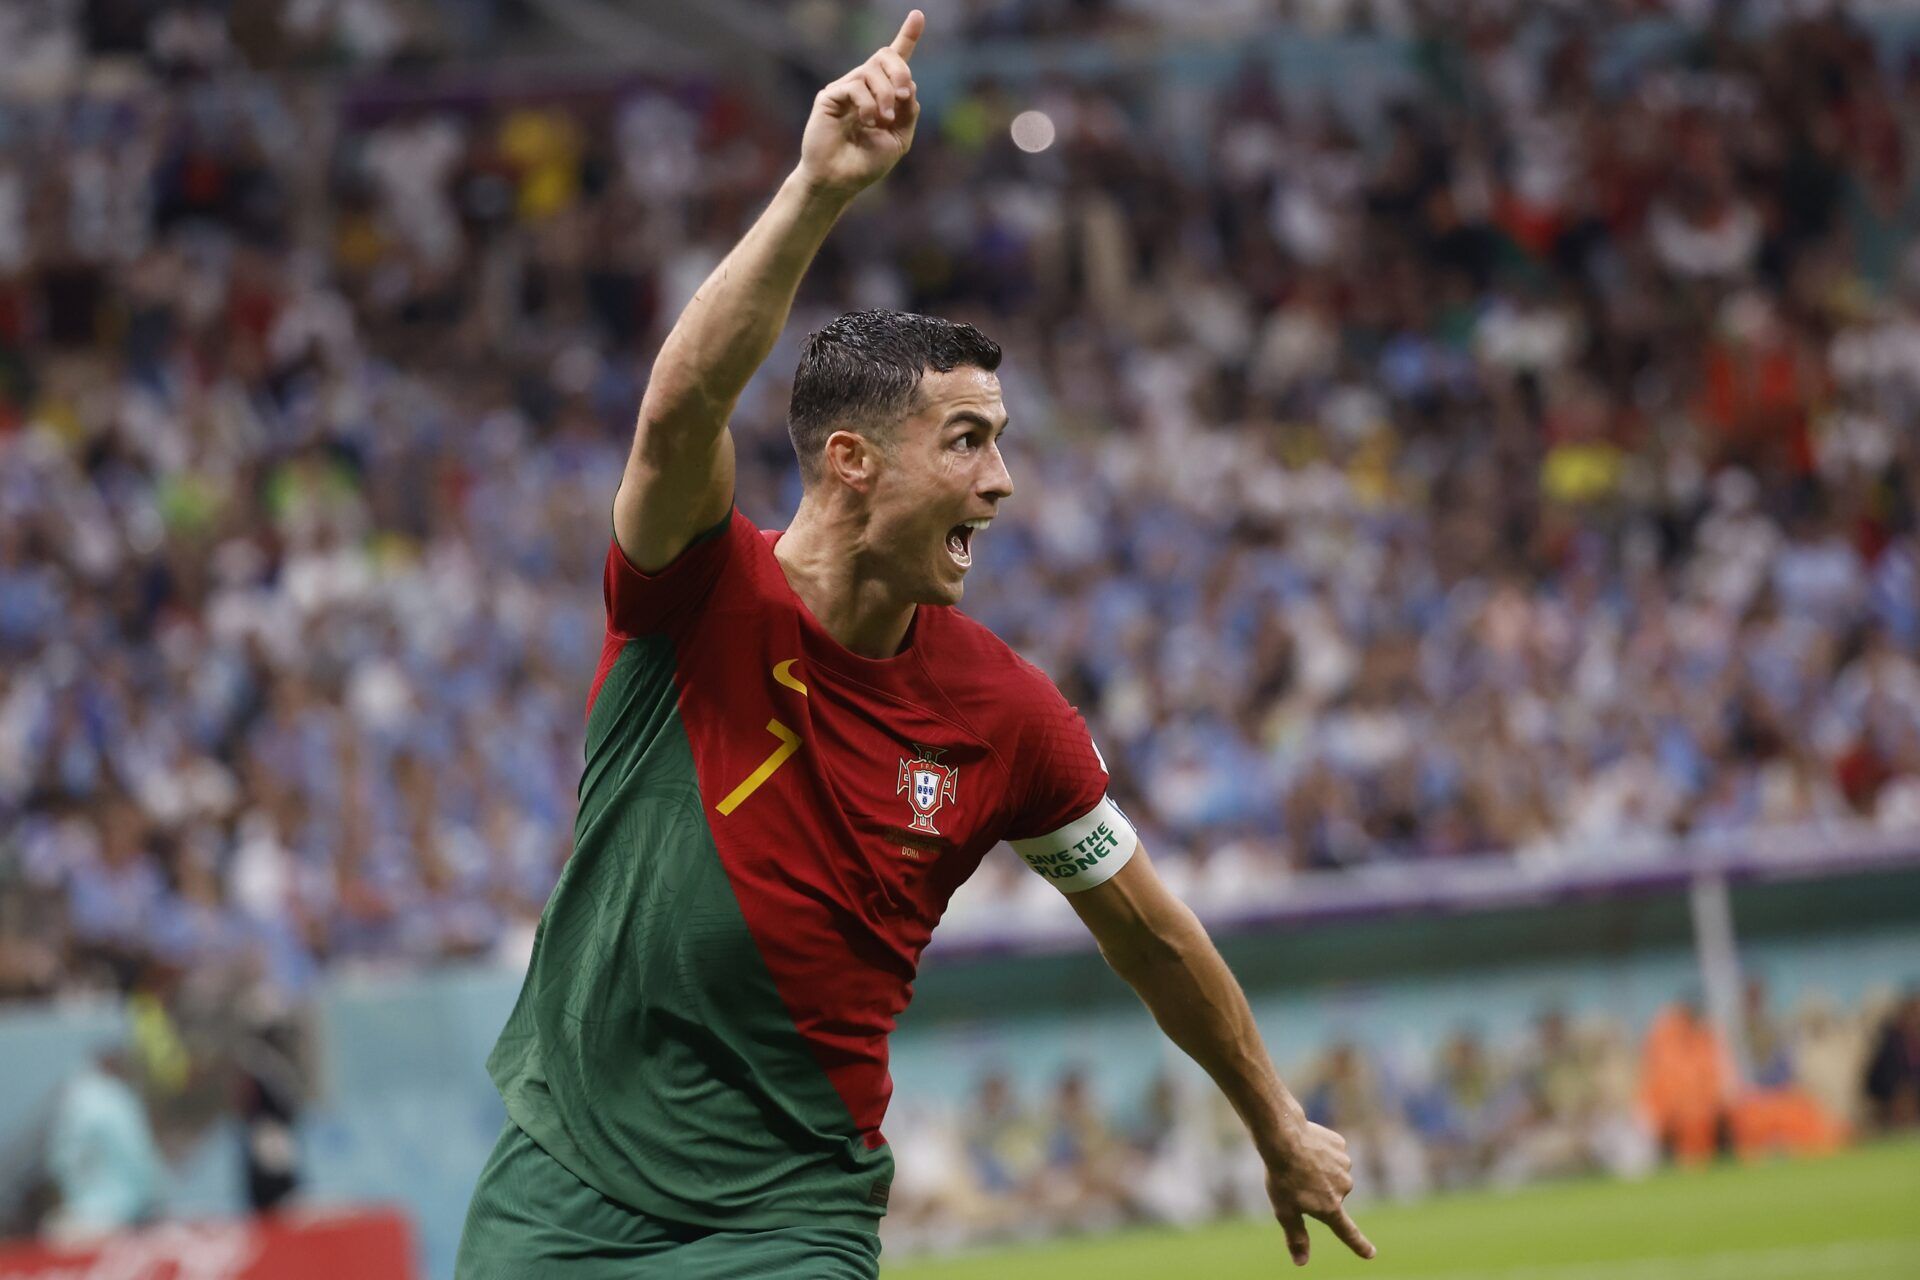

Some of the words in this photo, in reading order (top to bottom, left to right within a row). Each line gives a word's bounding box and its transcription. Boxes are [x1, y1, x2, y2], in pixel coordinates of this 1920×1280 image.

[715, 718, 802, 816] 7
[901, 846, 920, 859] DOHA
[1025, 849, 1073, 865] SAVE
[1073, 821, 1109, 853] THE
[1033, 830, 1119, 879] PLANET
